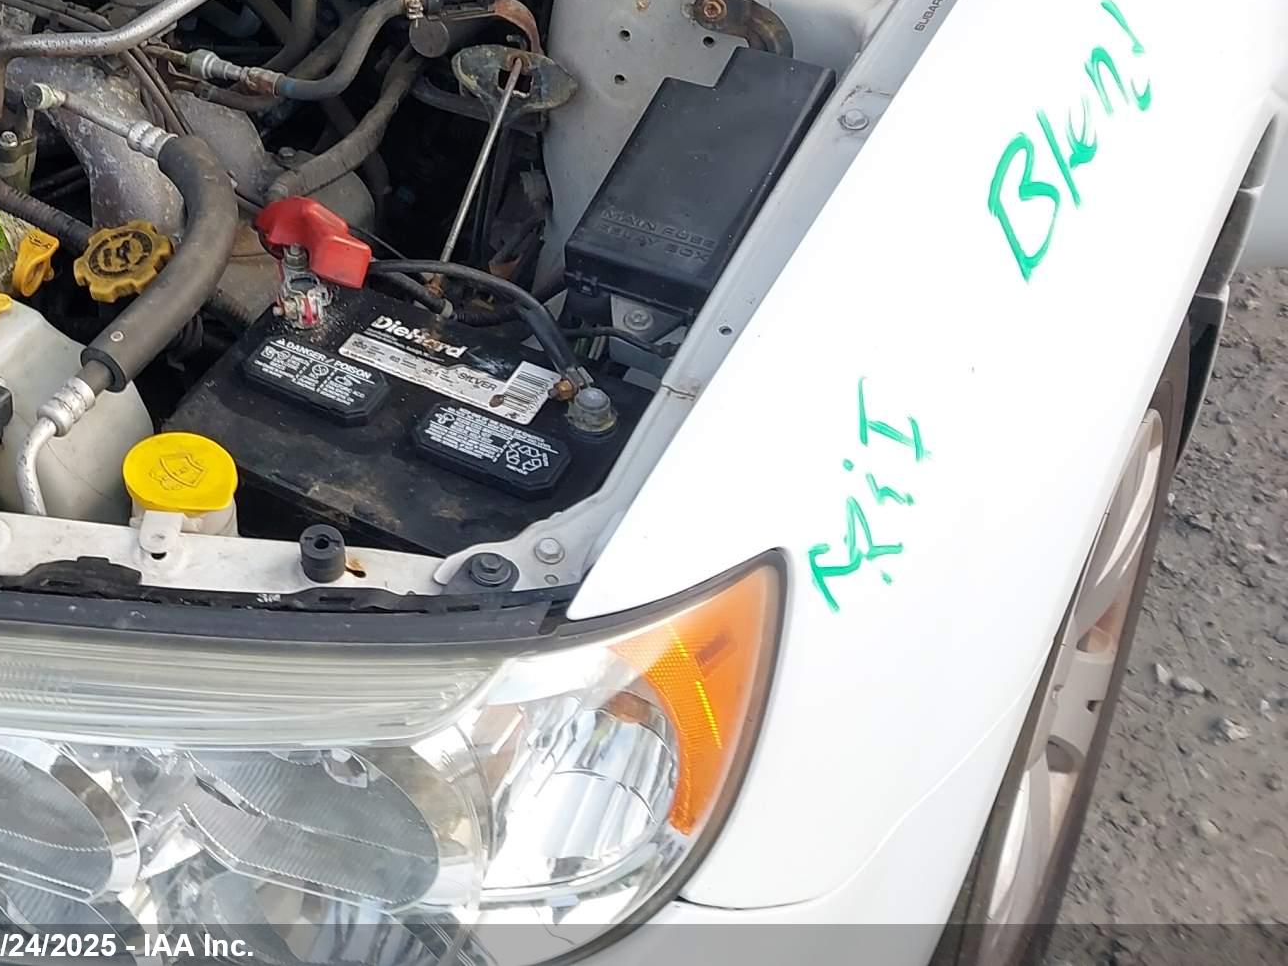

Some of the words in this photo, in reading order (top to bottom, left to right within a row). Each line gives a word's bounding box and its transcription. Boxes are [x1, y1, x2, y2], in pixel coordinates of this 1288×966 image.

[370, 315, 468, 358] DieHard
[285, 341, 328, 363] DANGER
[334, 360, 372, 379] POISON
[457, 371, 498, 392] SILVER
